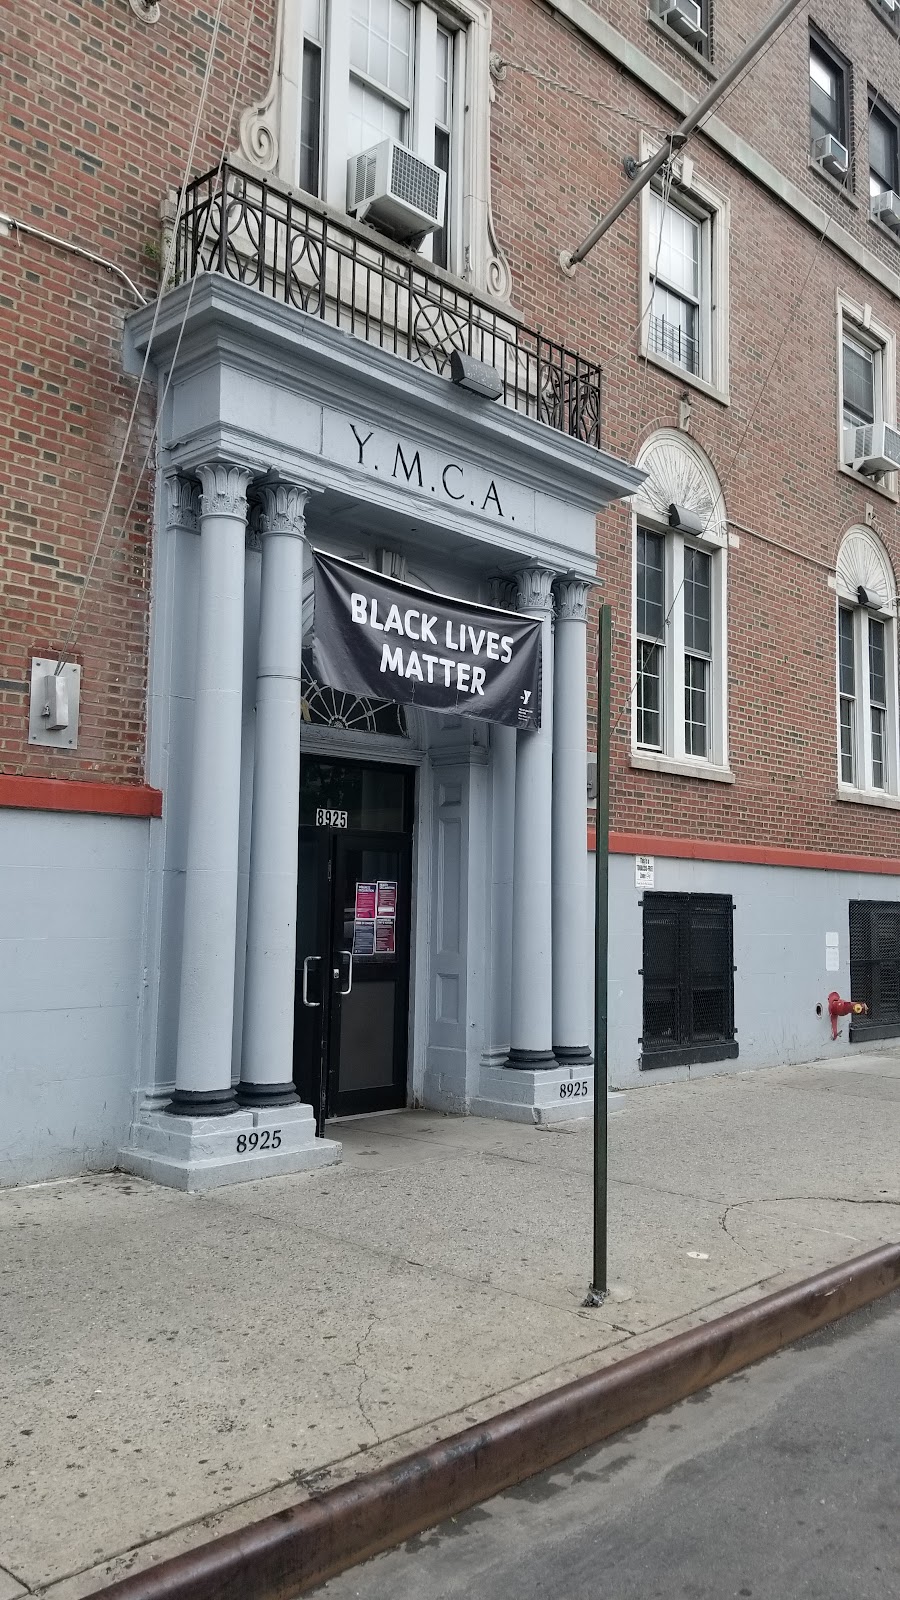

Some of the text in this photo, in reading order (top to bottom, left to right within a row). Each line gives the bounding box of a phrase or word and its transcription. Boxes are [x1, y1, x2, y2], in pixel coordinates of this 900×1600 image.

[351, 592, 514, 664] BLACK LIVES
[380, 643, 486, 696] MATTER
[317, 809, 347, 828] 8925
[559, 1081, 588, 1099] 8925
[236, 1129, 282, 1154] 8925
